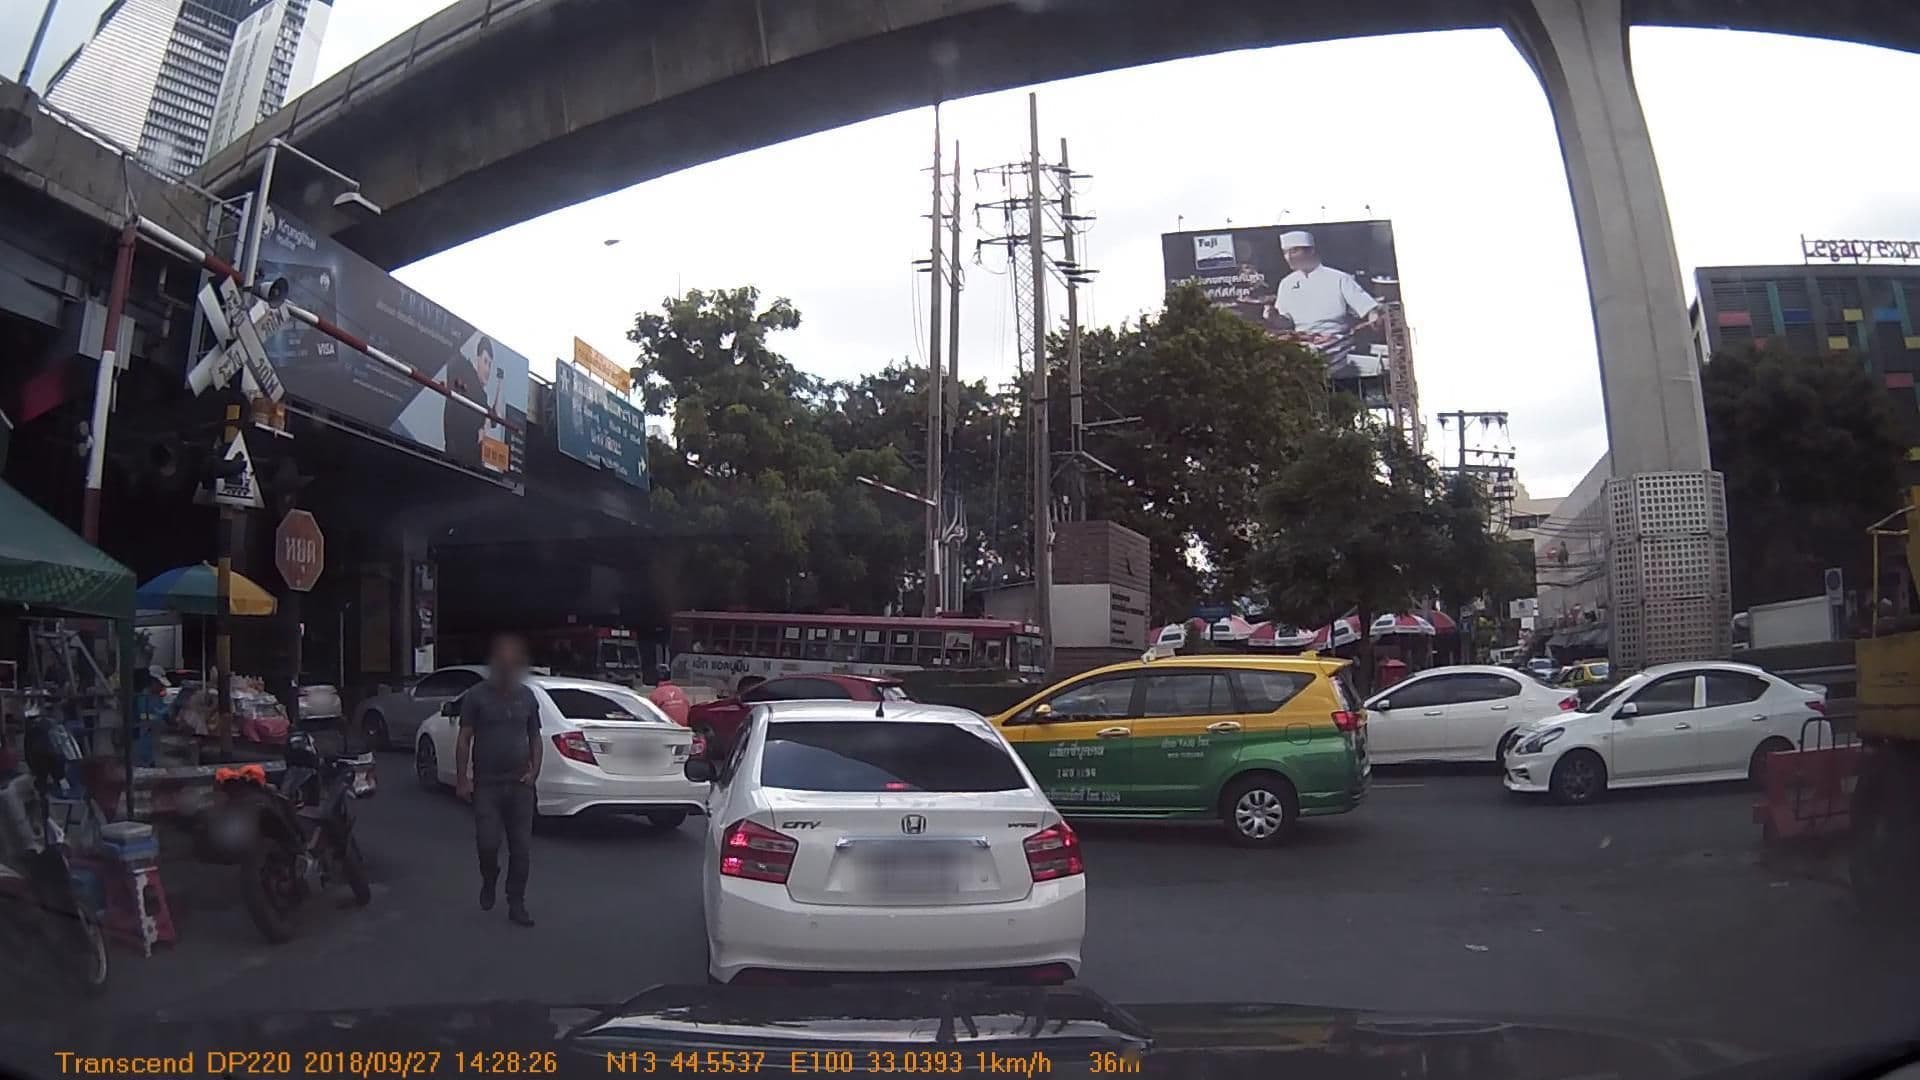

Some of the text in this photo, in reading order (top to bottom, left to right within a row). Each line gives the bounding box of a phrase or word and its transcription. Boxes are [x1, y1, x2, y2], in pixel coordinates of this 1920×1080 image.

[1198, 238, 1218, 248] Fuji
[1801, 234, 1872, 263] Legacy
[317, 343, 335, 355] VISA
[782, 820, 822, 830] CITY
